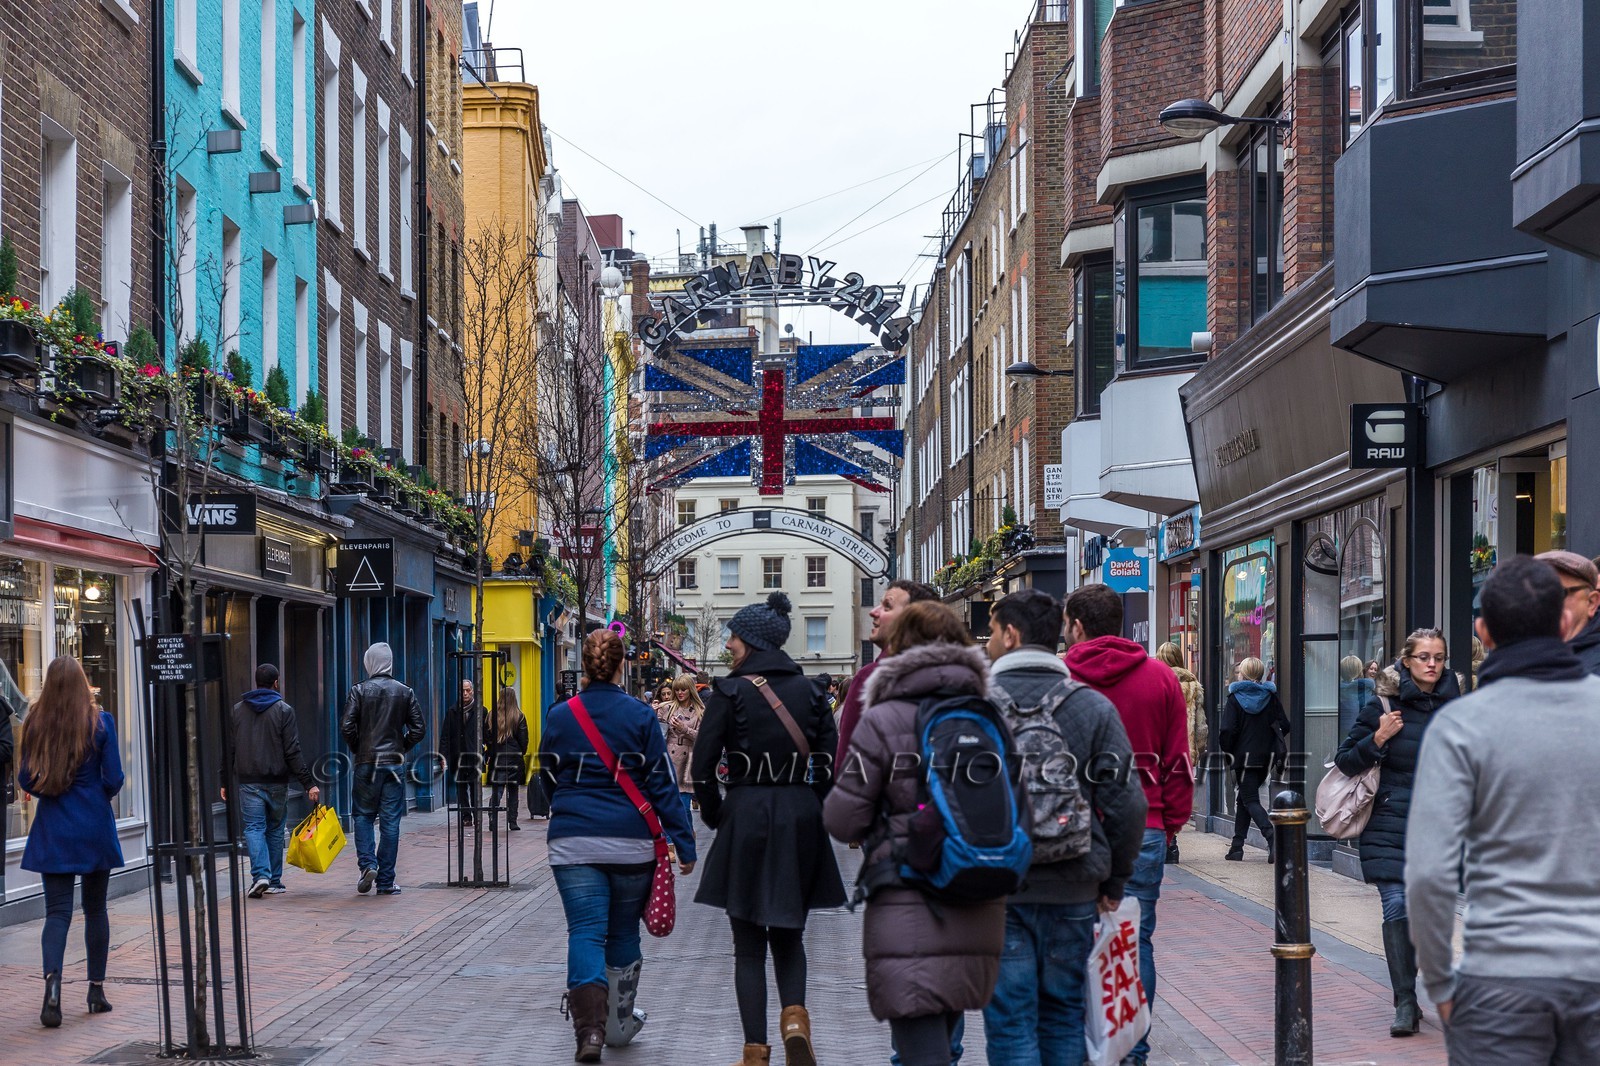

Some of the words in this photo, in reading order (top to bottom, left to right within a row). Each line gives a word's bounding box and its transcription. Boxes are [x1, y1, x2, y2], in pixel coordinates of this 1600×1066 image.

[638, 253, 836, 346] CARNABY
[834, 271, 914, 345] 2014
[1367, 448, 1405, 459] RAW
[186, 503, 237, 526] VANS
[339, 542, 390, 550] ELEVENPARIS
[657, 527, 708, 561] WELCOME
[716, 519, 732, 531] TO
[781, 515, 836, 539] CARNABY
[839, 536, 878, 567] STREET
[1110, 567, 1141, 577] Goliath
[1102, 951, 1139, 1005] SA
[1105, 980, 1148, 1039] SAE
